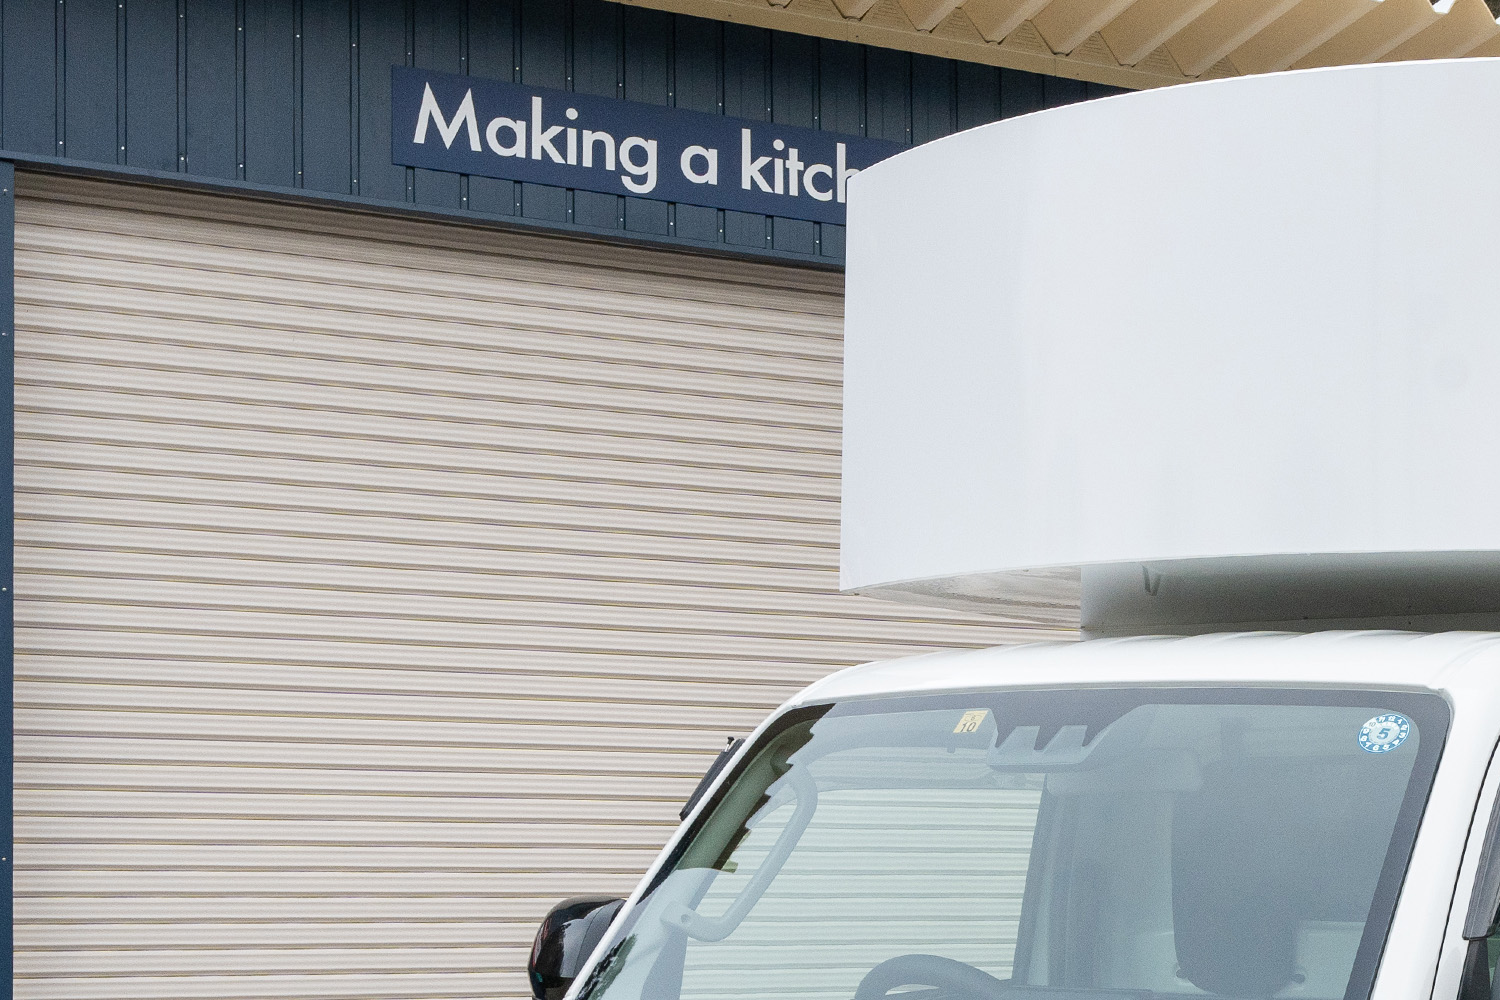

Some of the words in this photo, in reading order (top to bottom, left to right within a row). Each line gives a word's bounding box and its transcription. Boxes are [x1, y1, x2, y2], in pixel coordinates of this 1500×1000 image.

[413, 81, 658, 194] Making
[680, 145, 718, 186] a
[741, 128, 861, 204] kitch
[960, 721, 977, 732] 10
[1377, 728, 1391, 740] 5
